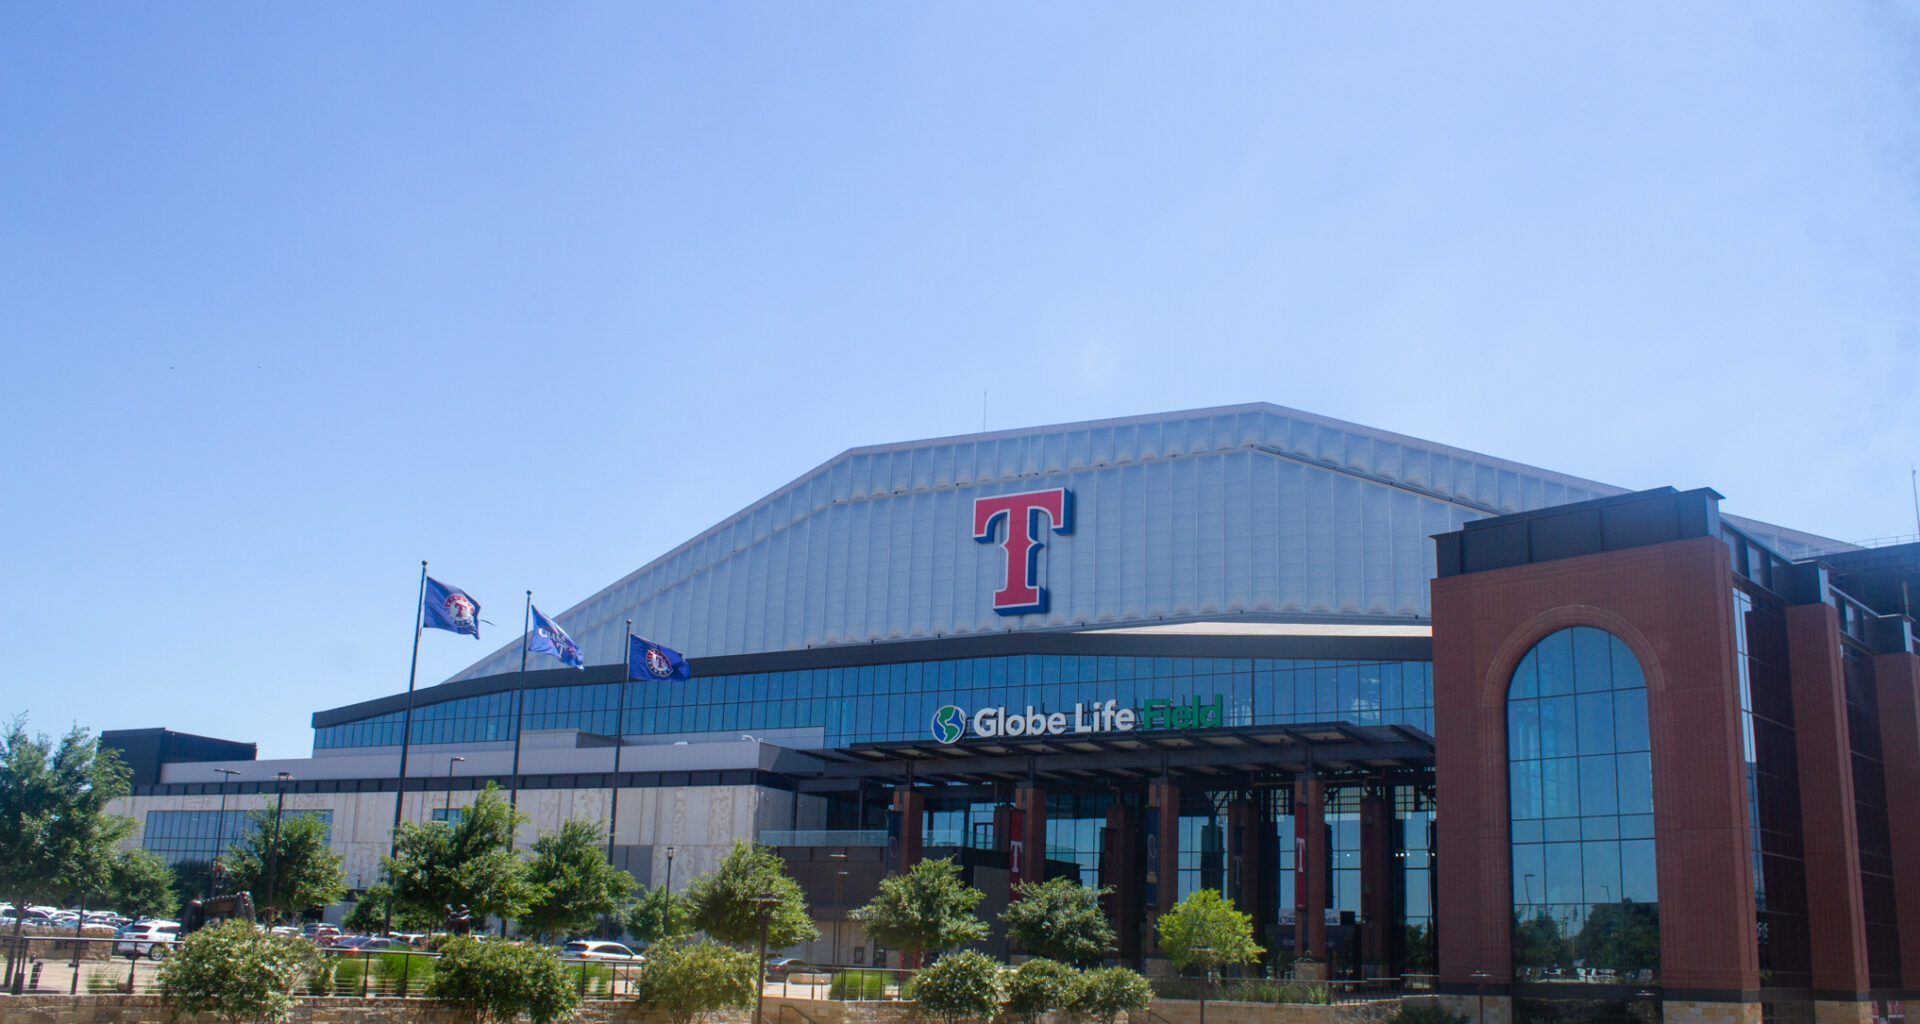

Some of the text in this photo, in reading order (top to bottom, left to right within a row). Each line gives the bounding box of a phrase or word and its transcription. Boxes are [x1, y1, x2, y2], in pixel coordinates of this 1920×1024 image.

[973, 487, 1071, 616] T
[973, 693, 1223, 738] Globe Life Field
[1010, 840, 1023, 873] T
[1296, 837, 1305, 873] T
